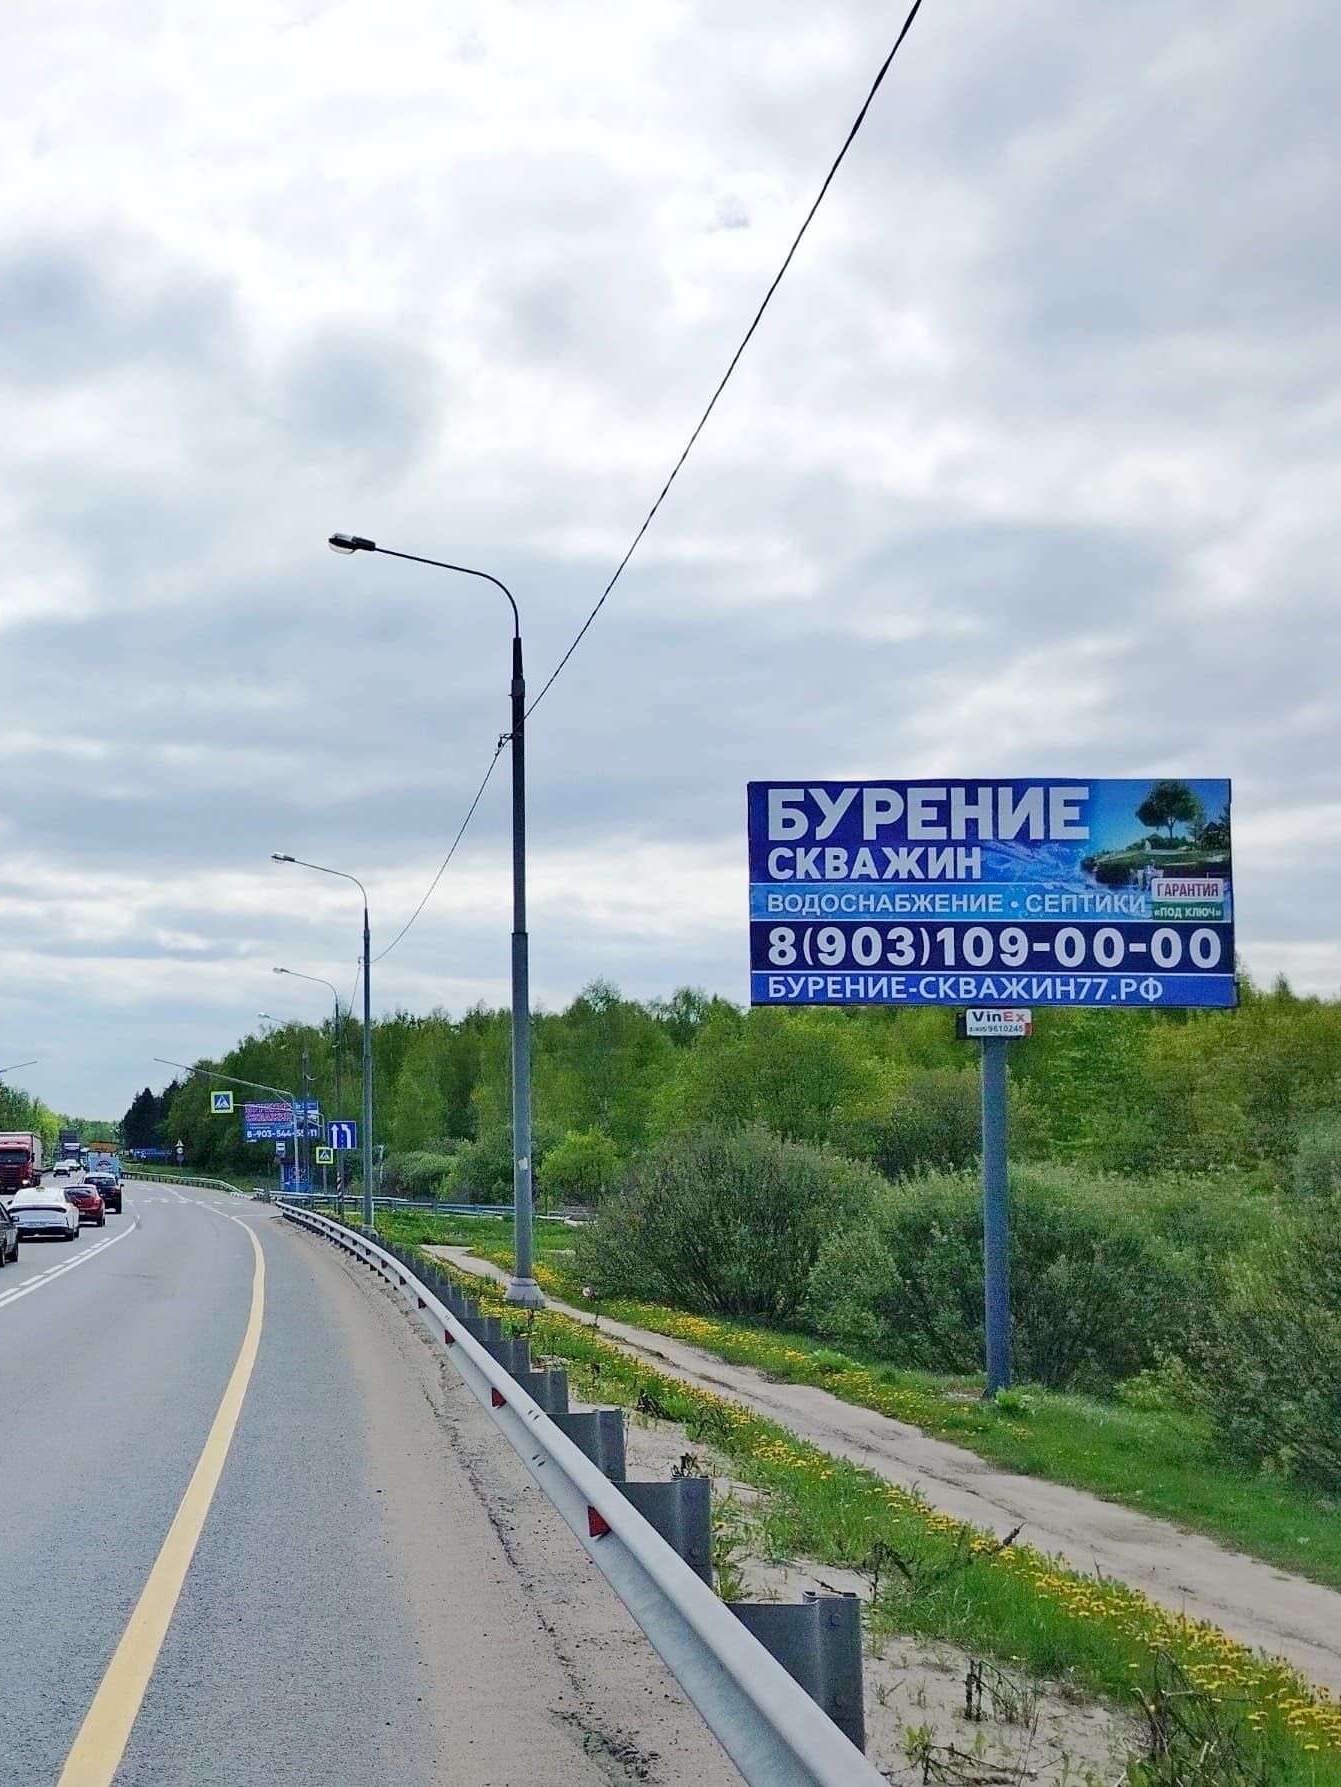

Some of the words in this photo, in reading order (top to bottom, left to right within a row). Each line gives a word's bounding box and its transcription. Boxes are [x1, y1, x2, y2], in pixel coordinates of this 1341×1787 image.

[768, 787, 1090, 841] БУРЕНИЕ
[767, 847, 981, 880] СКВАЖИН
[1157, 883, 1219, 897] ГАРАНТИЯ
[767, 894, 1004, 916] ВОДОСНАБЖЕНИЕ
[1025, 894, 1147, 913] СЕПТИКИ
[768, 926, 1222, 969] 8(903)109-00-00
[768, 976, 1163, 1002] БУРЕНИЕ-СКВАЖИН77.РФ
[972, 1011, 1025, 1022] VinEx
